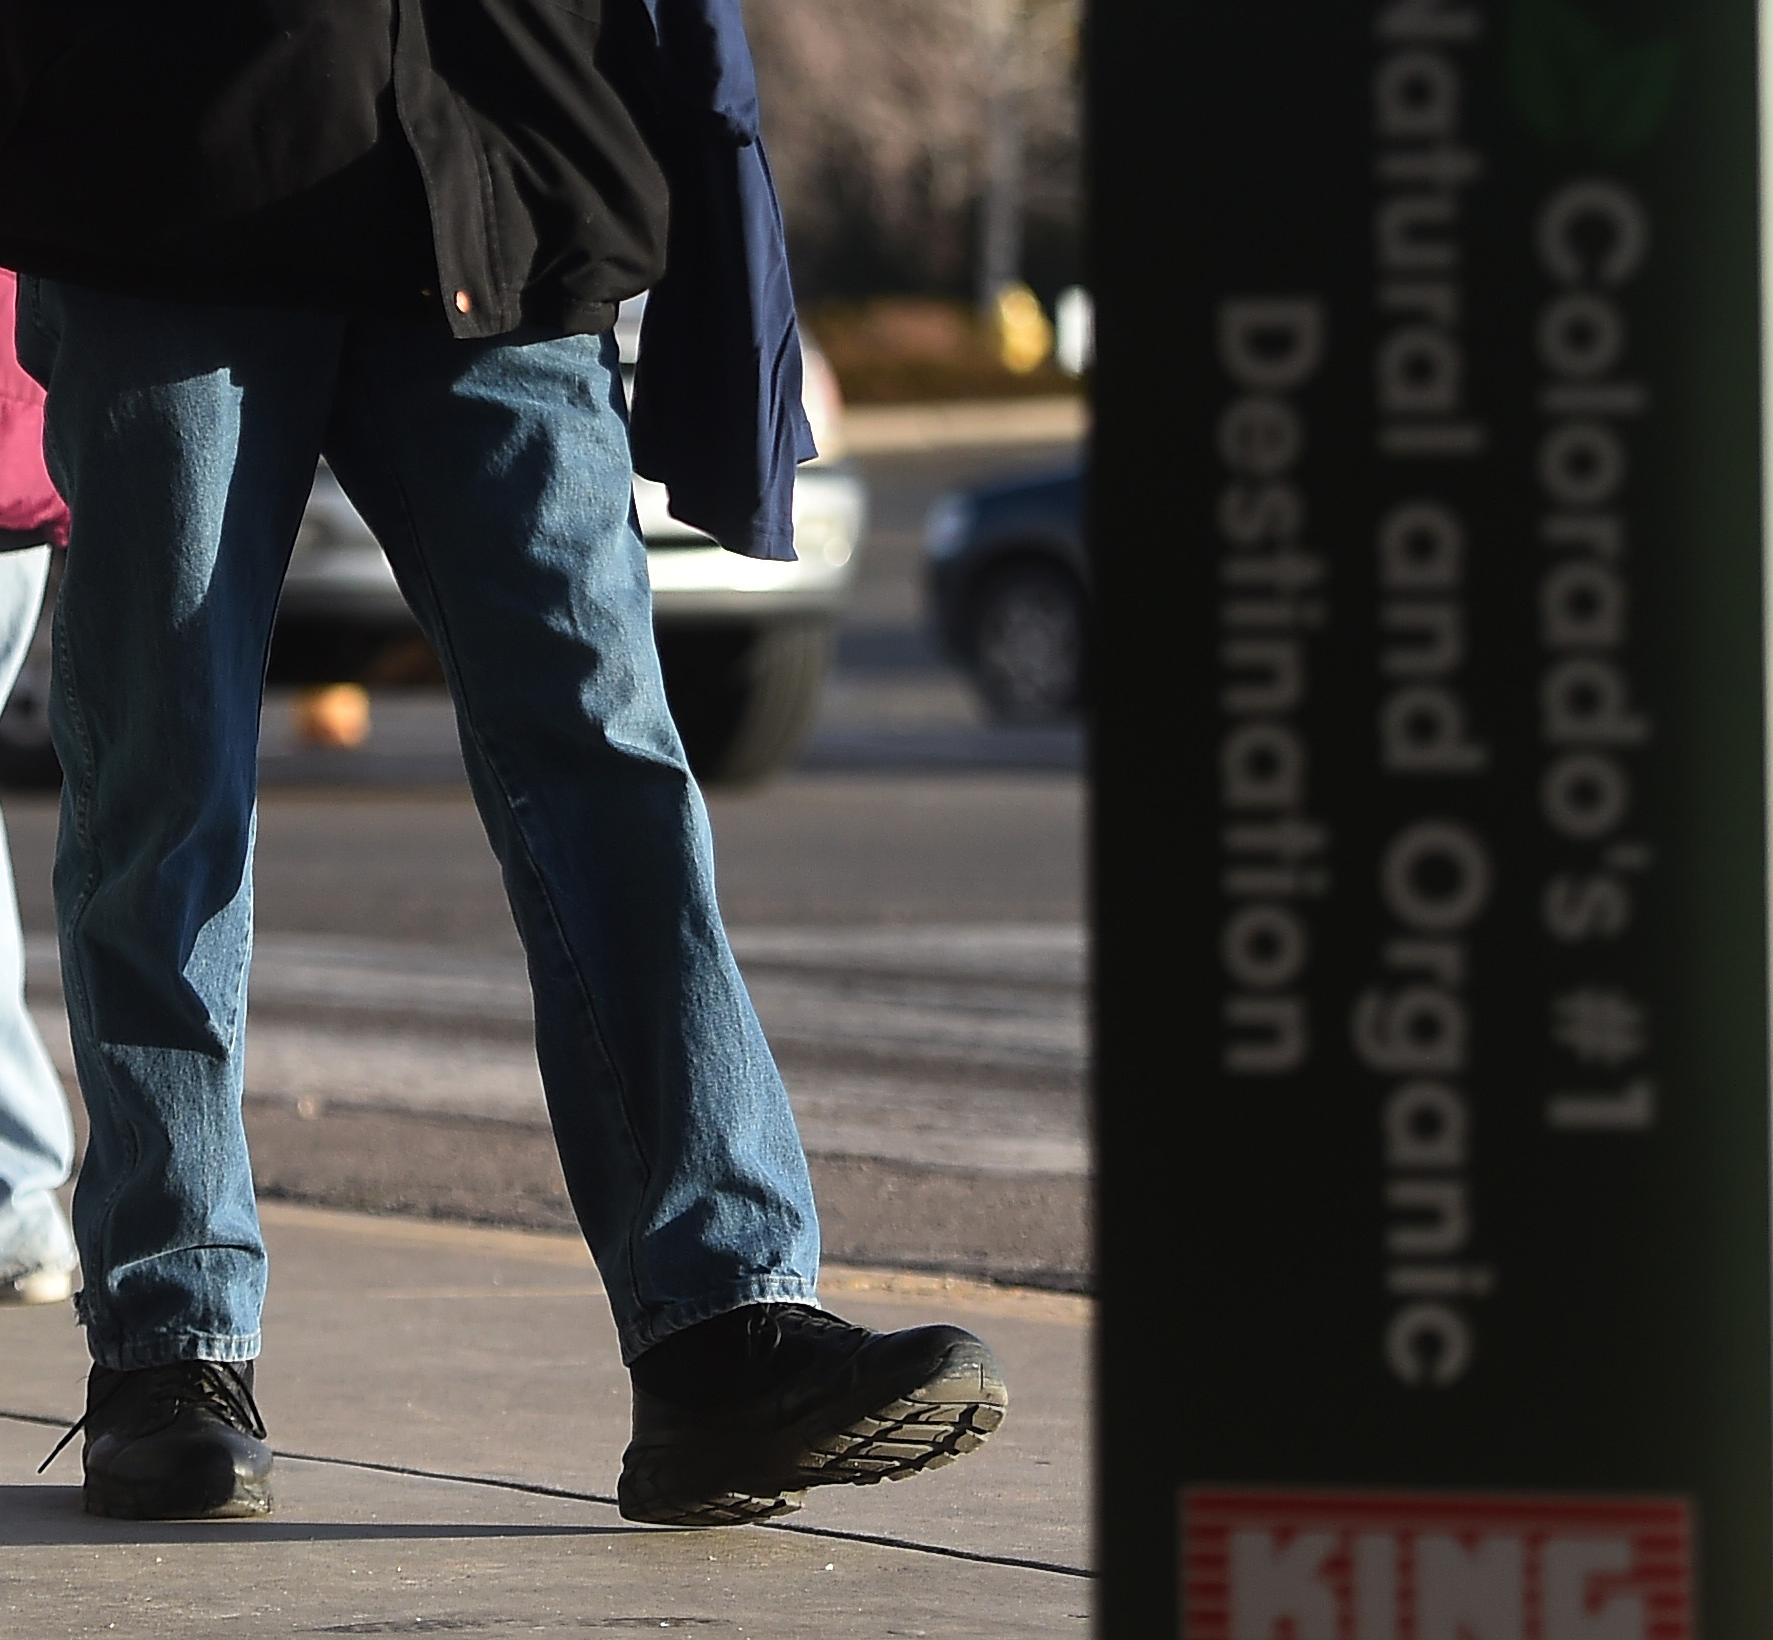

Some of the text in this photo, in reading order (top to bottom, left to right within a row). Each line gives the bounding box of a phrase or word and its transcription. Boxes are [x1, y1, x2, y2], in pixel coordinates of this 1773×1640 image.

[1217, 296, 1331, 1072] Destination
[1376, 502, 1489, 774] and
[1536, 180, 1658, 1129] Colorado's #1
[1353, 821, 1496, 1386] Organic
[1228, 1530, 1648, 1640] KING
